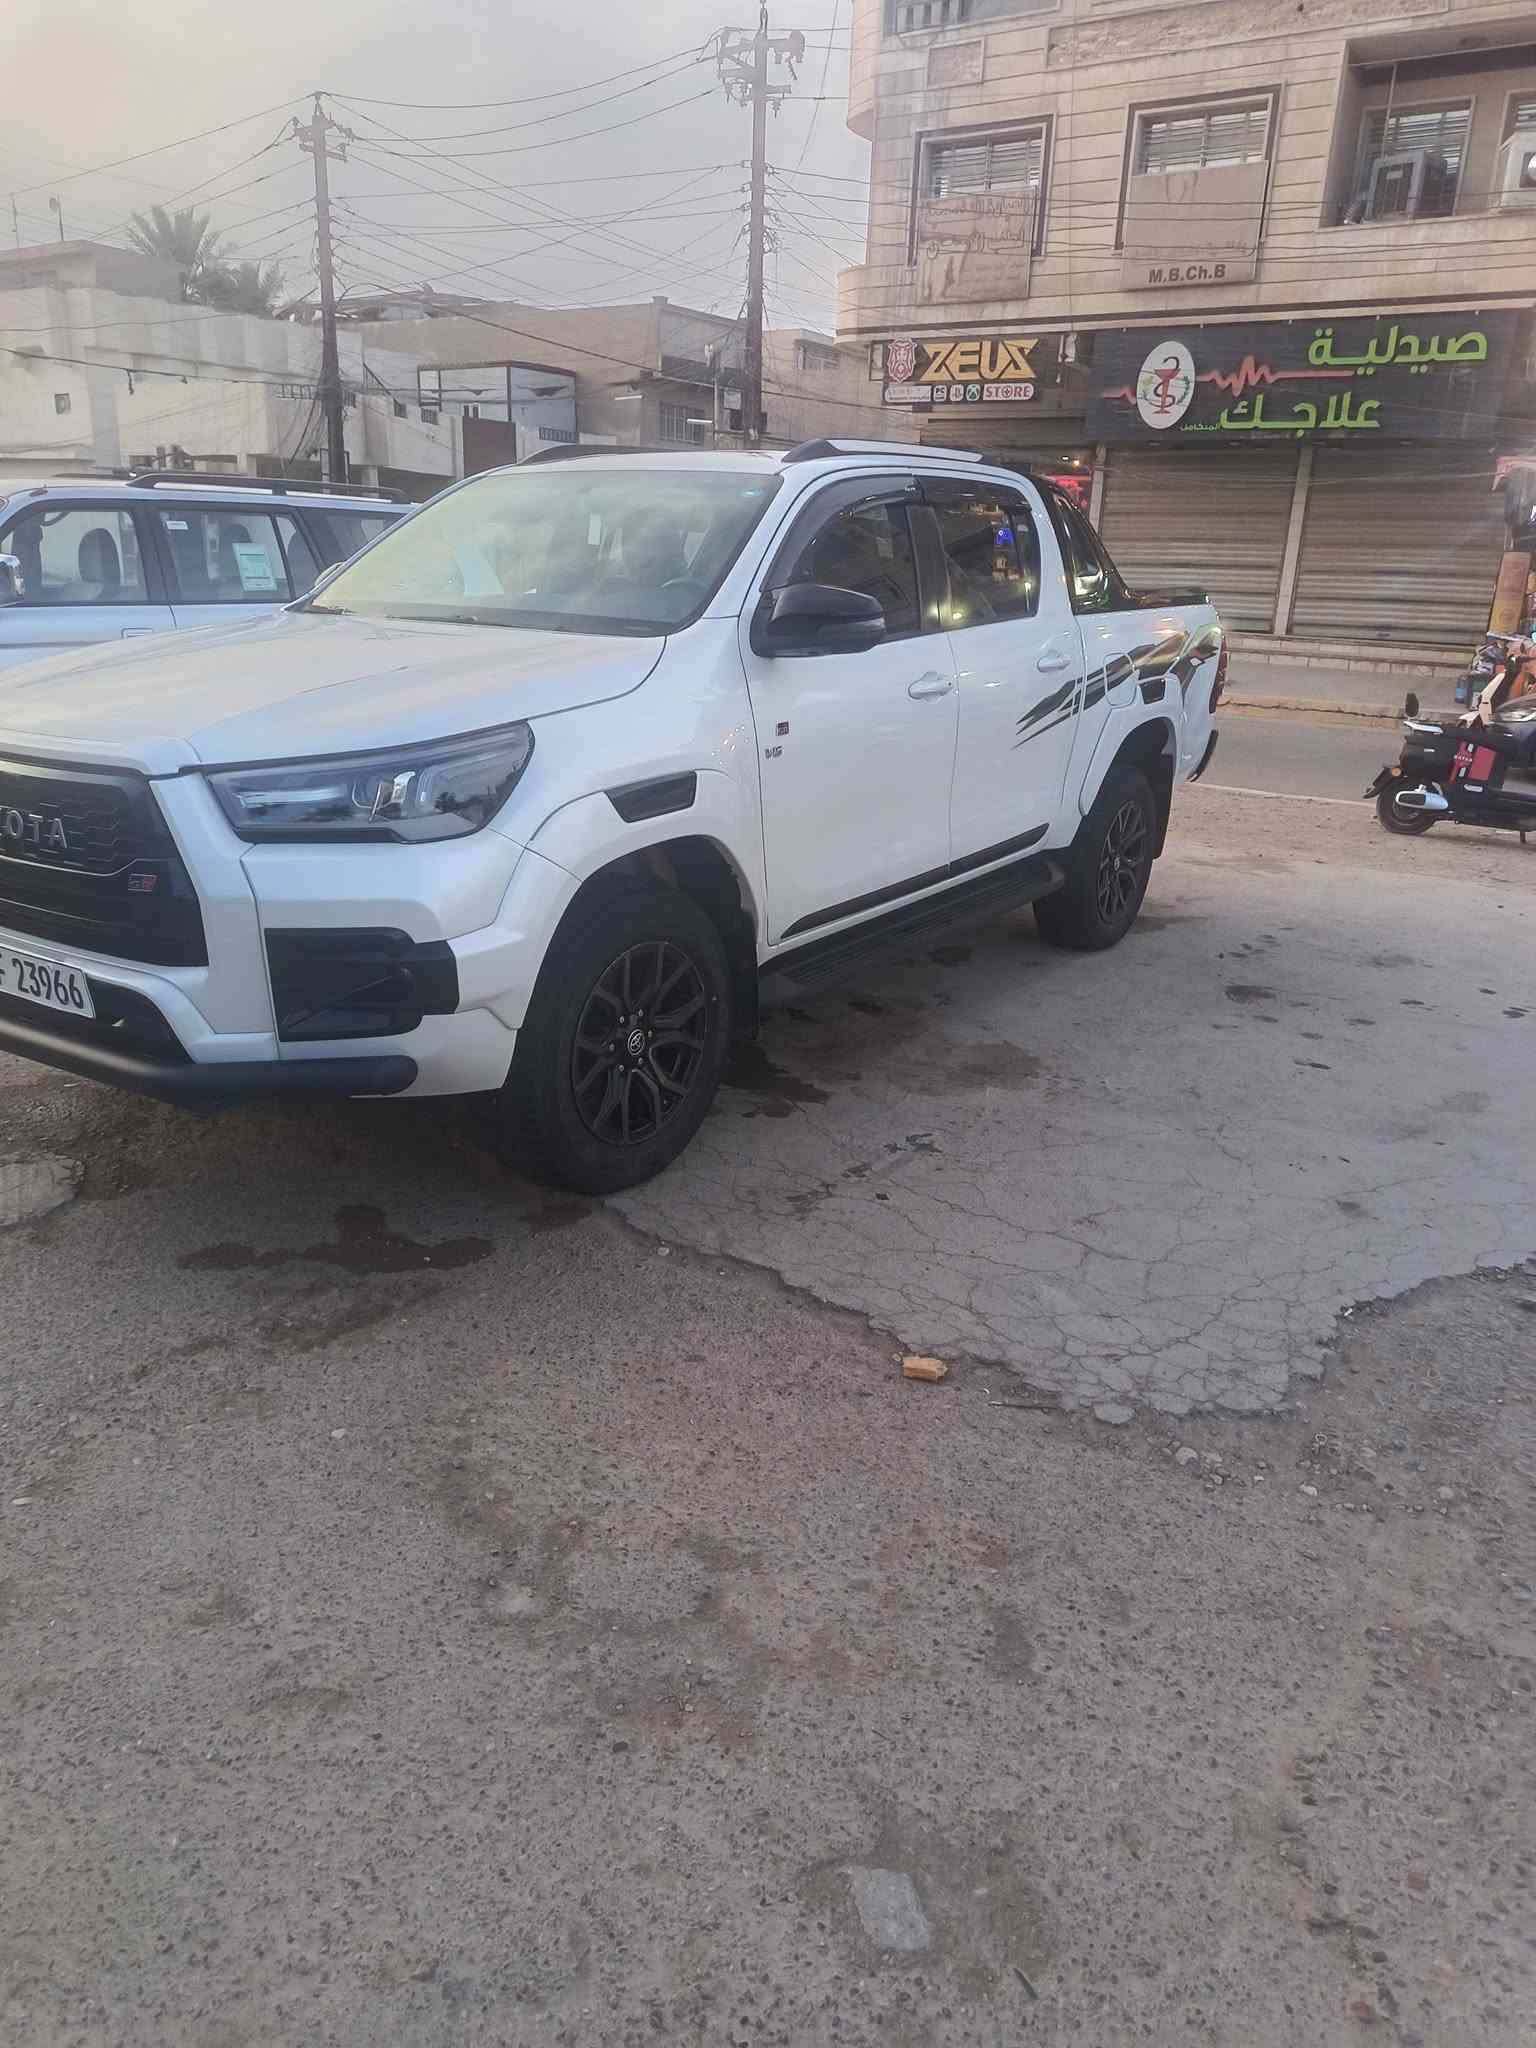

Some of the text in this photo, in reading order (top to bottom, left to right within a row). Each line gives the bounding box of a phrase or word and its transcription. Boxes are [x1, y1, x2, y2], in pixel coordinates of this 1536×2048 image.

[1149, 264, 1226, 283] M.B.Ch.B
[920, 339, 1039, 381] ZEUS
[1308, 325, 1488, 375] صيدلية
[985, 385, 1031, 399] STORE
[1220, 392, 1382, 438] علاجك
[0, 808, 68, 849] OTA
[11, 957, 84, 1010] 23966
